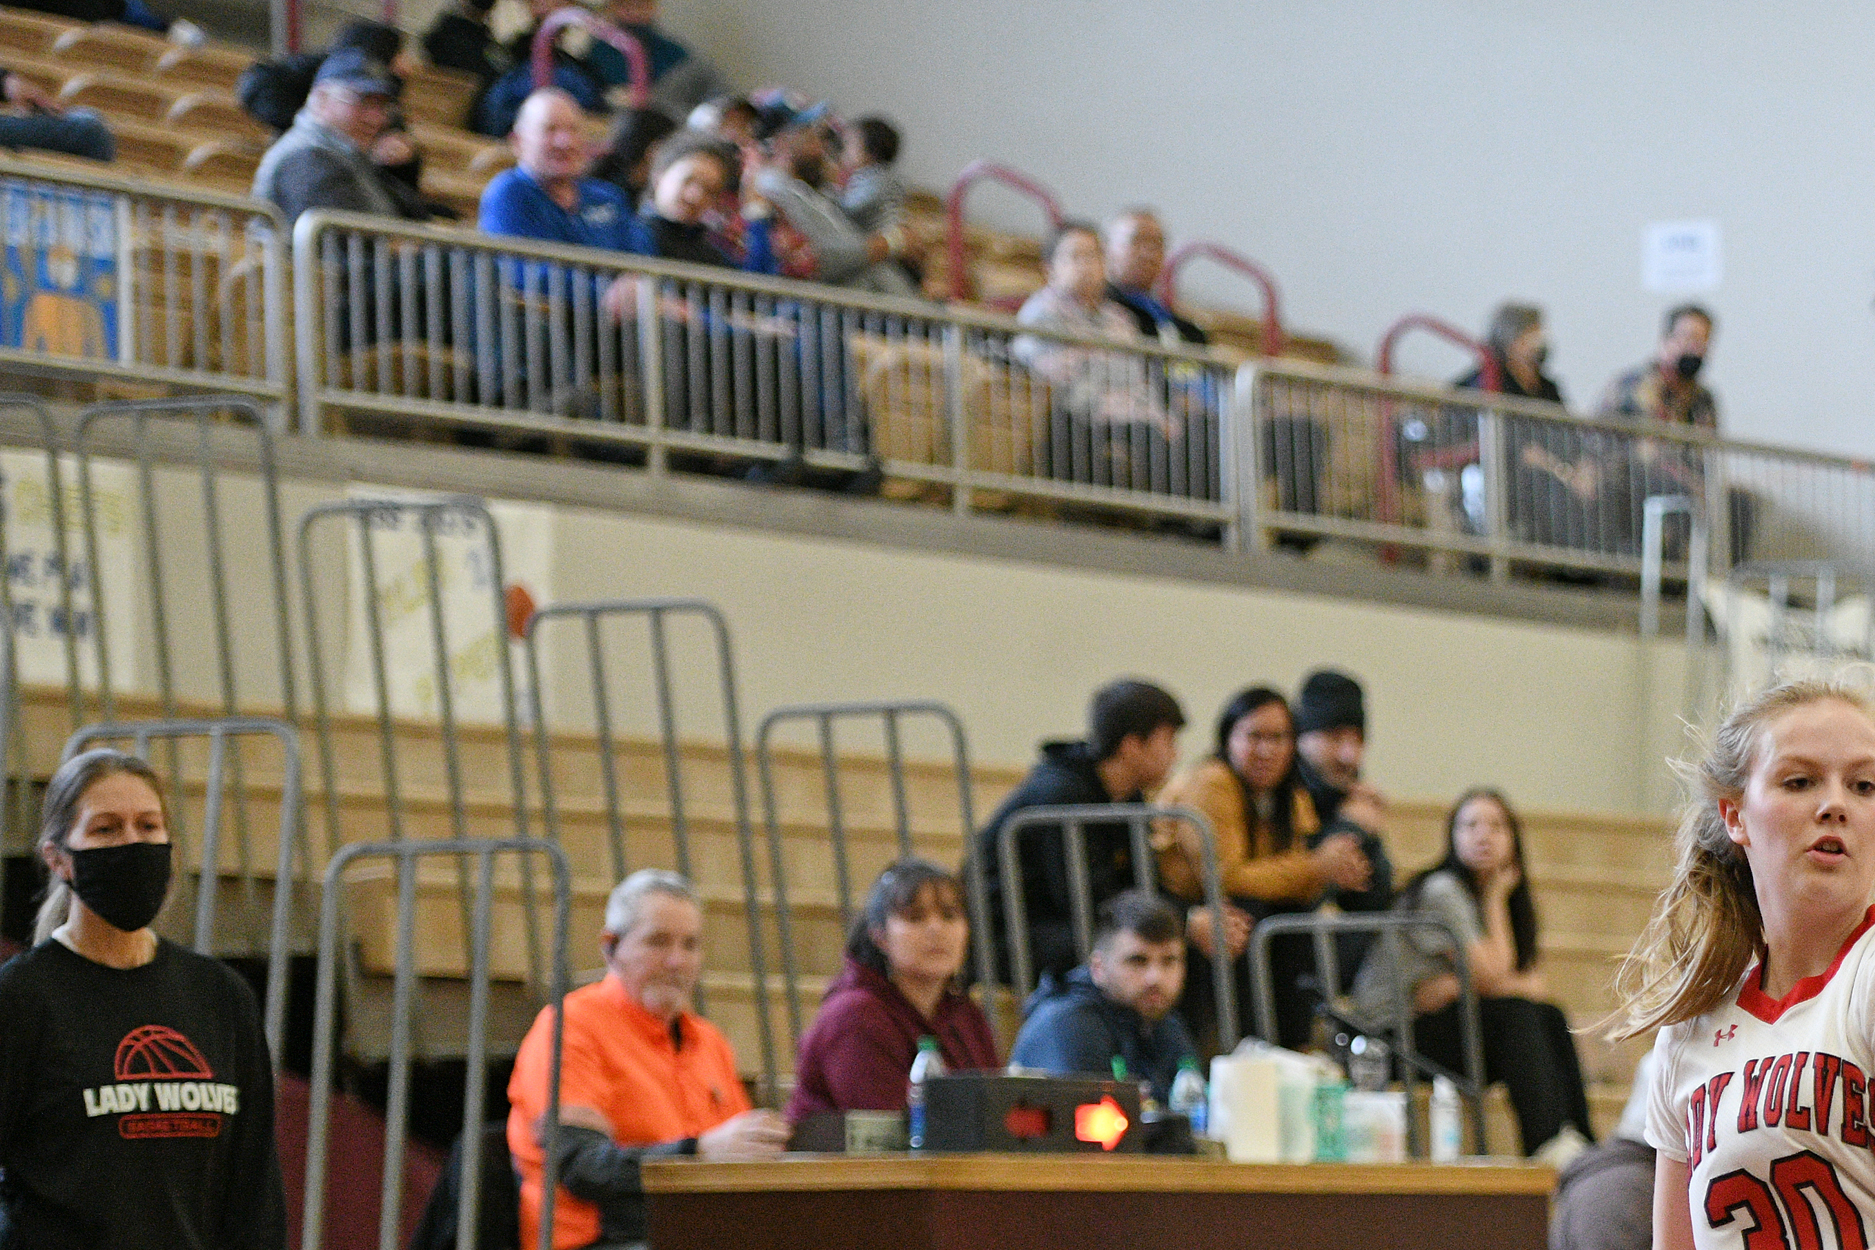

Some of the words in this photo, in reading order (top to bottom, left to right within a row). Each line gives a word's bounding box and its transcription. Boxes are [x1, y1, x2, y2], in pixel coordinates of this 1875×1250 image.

[83, 1083, 150, 1118] LADY
[154, 1081, 239, 1115] WOLVE
[1686, 1071, 1735, 1174] DY
